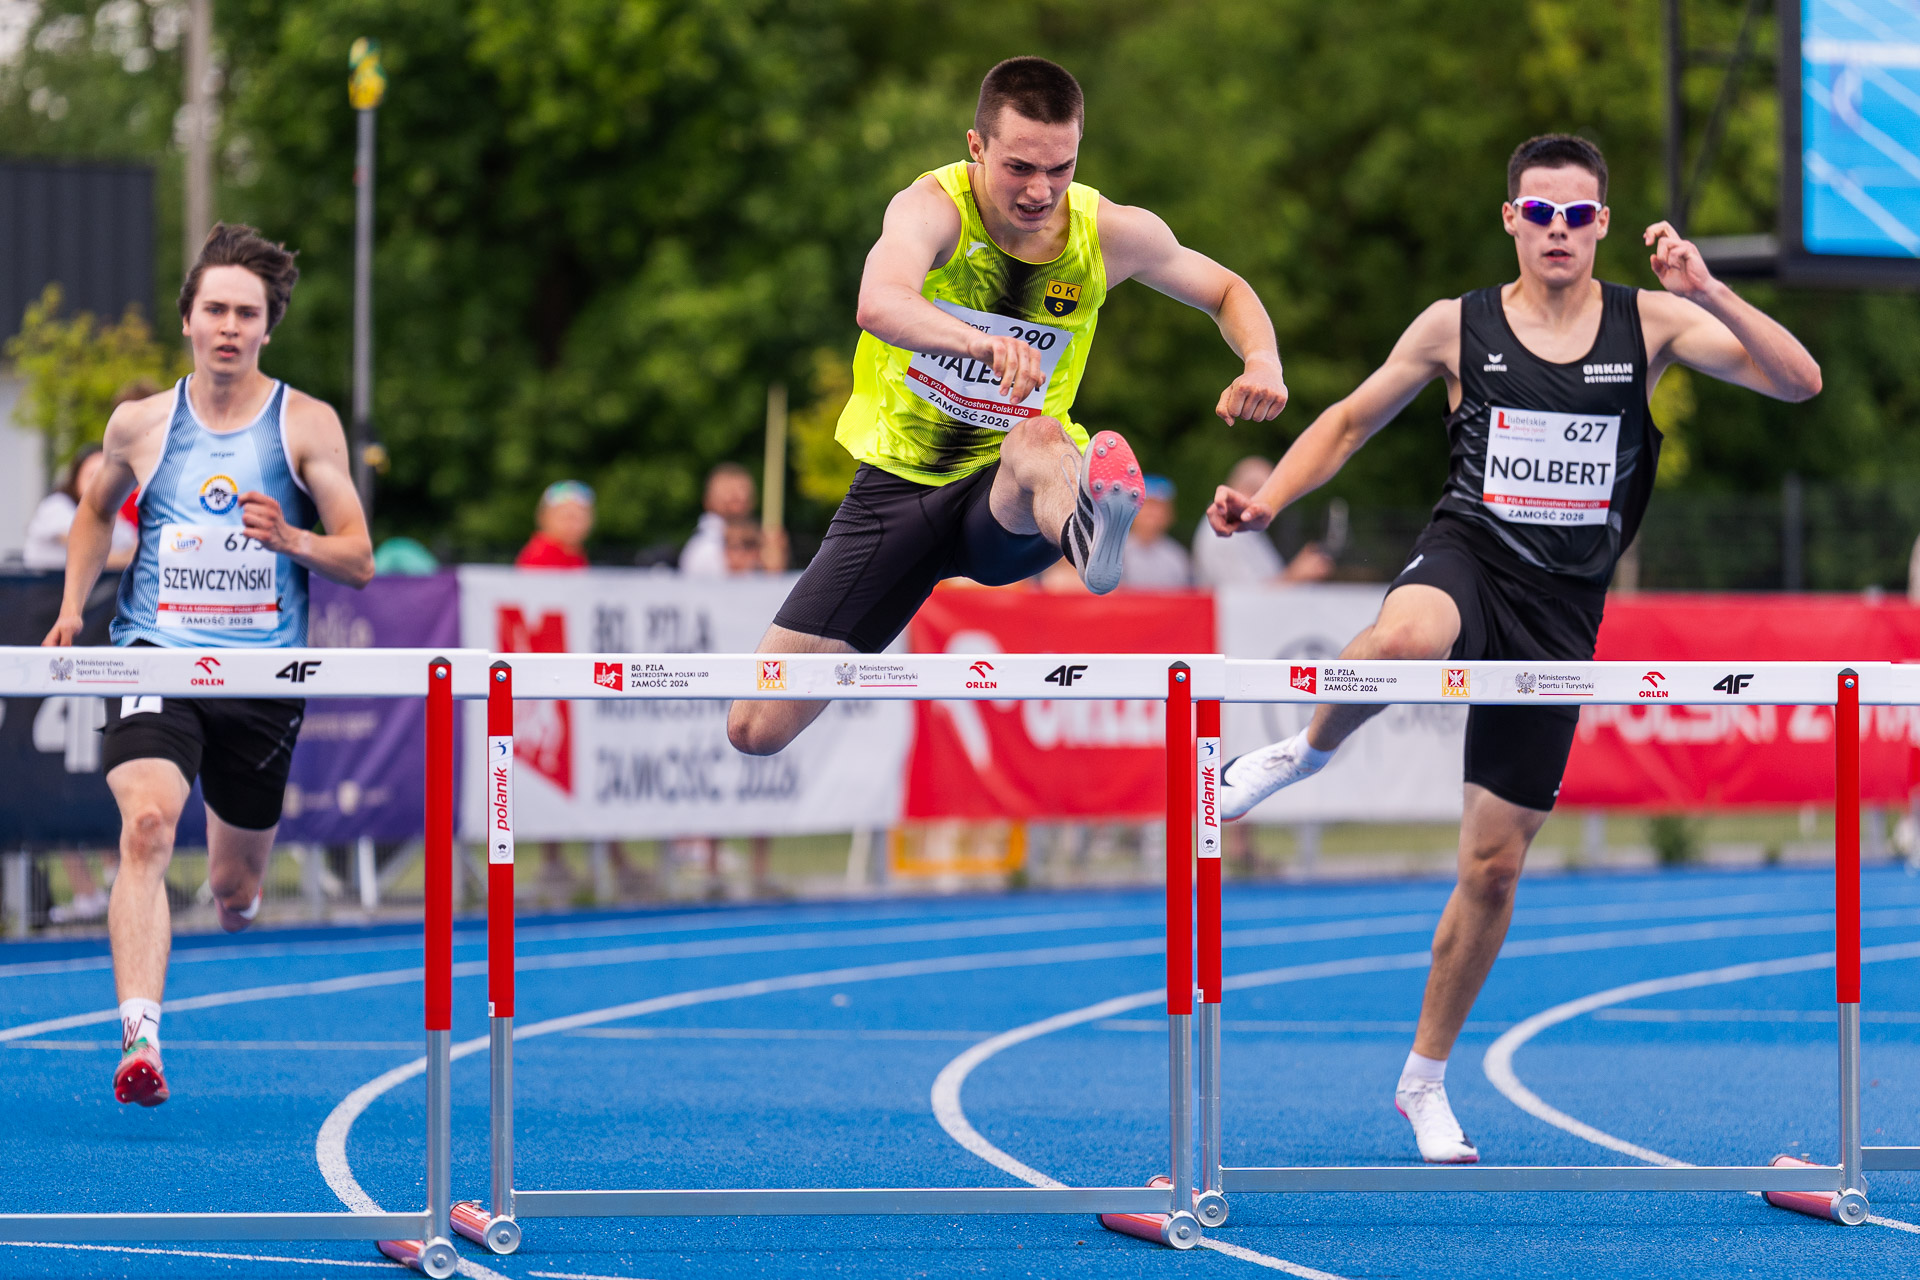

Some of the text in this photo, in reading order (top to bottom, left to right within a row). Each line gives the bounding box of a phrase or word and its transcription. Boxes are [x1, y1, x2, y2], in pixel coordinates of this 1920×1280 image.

[1008, 325, 1056, 351] 290
[1582, 363, 1634, 375] ORKAN
[930, 380, 948, 395] PZLA
[946, 391, 991, 410] Mistrzostwa
[991, 403, 1014, 415] Polski
[1014, 408, 1030, 417] U20
[928, 391, 1010, 429] ZAMOŚĆ 2026
[1563, 421, 1609, 444] 627
[1489, 454, 1612, 486] NOLBERT
[1508, 509, 1557, 520] ZAMOŚĆ
[163, 563, 272, 591] SZEWCZYŃSKI
[75, 658, 125, 667] Ministerstwo
[630, 663, 665, 672] 80. PZLA
[859, 664, 905, 672] Ministerstwo
[75, 667, 101, 678] Sportu
[106, 667, 140, 677] Turystyki
[275, 660, 323, 683] 4F
[859, 672, 883, 682] Sportu
[887, 672, 919, 682] Turystyki
[1044, 664, 1089, 687] 4F
[1324, 668, 1356, 676] 80. PZLA
[190, 677, 225, 686] ORLEN
[630, 679, 668, 688] ZAMOŚĆ
[758, 680, 785, 689] PZLA
[965, 681, 997, 689] ORLEN
[1324, 682, 1378, 692] ZAMOŚĆ 2026
[1538, 681, 1560, 690] Sportu
[1565, 681, 1595, 690] Turystyki
[1712, 673, 1755, 695] 4F
[1443, 687, 1469, 696] PZLA
[1638, 690, 1669, 698] ORLEN
[493, 766, 511, 832] polanik
[1201, 766, 1218, 828] polanik
